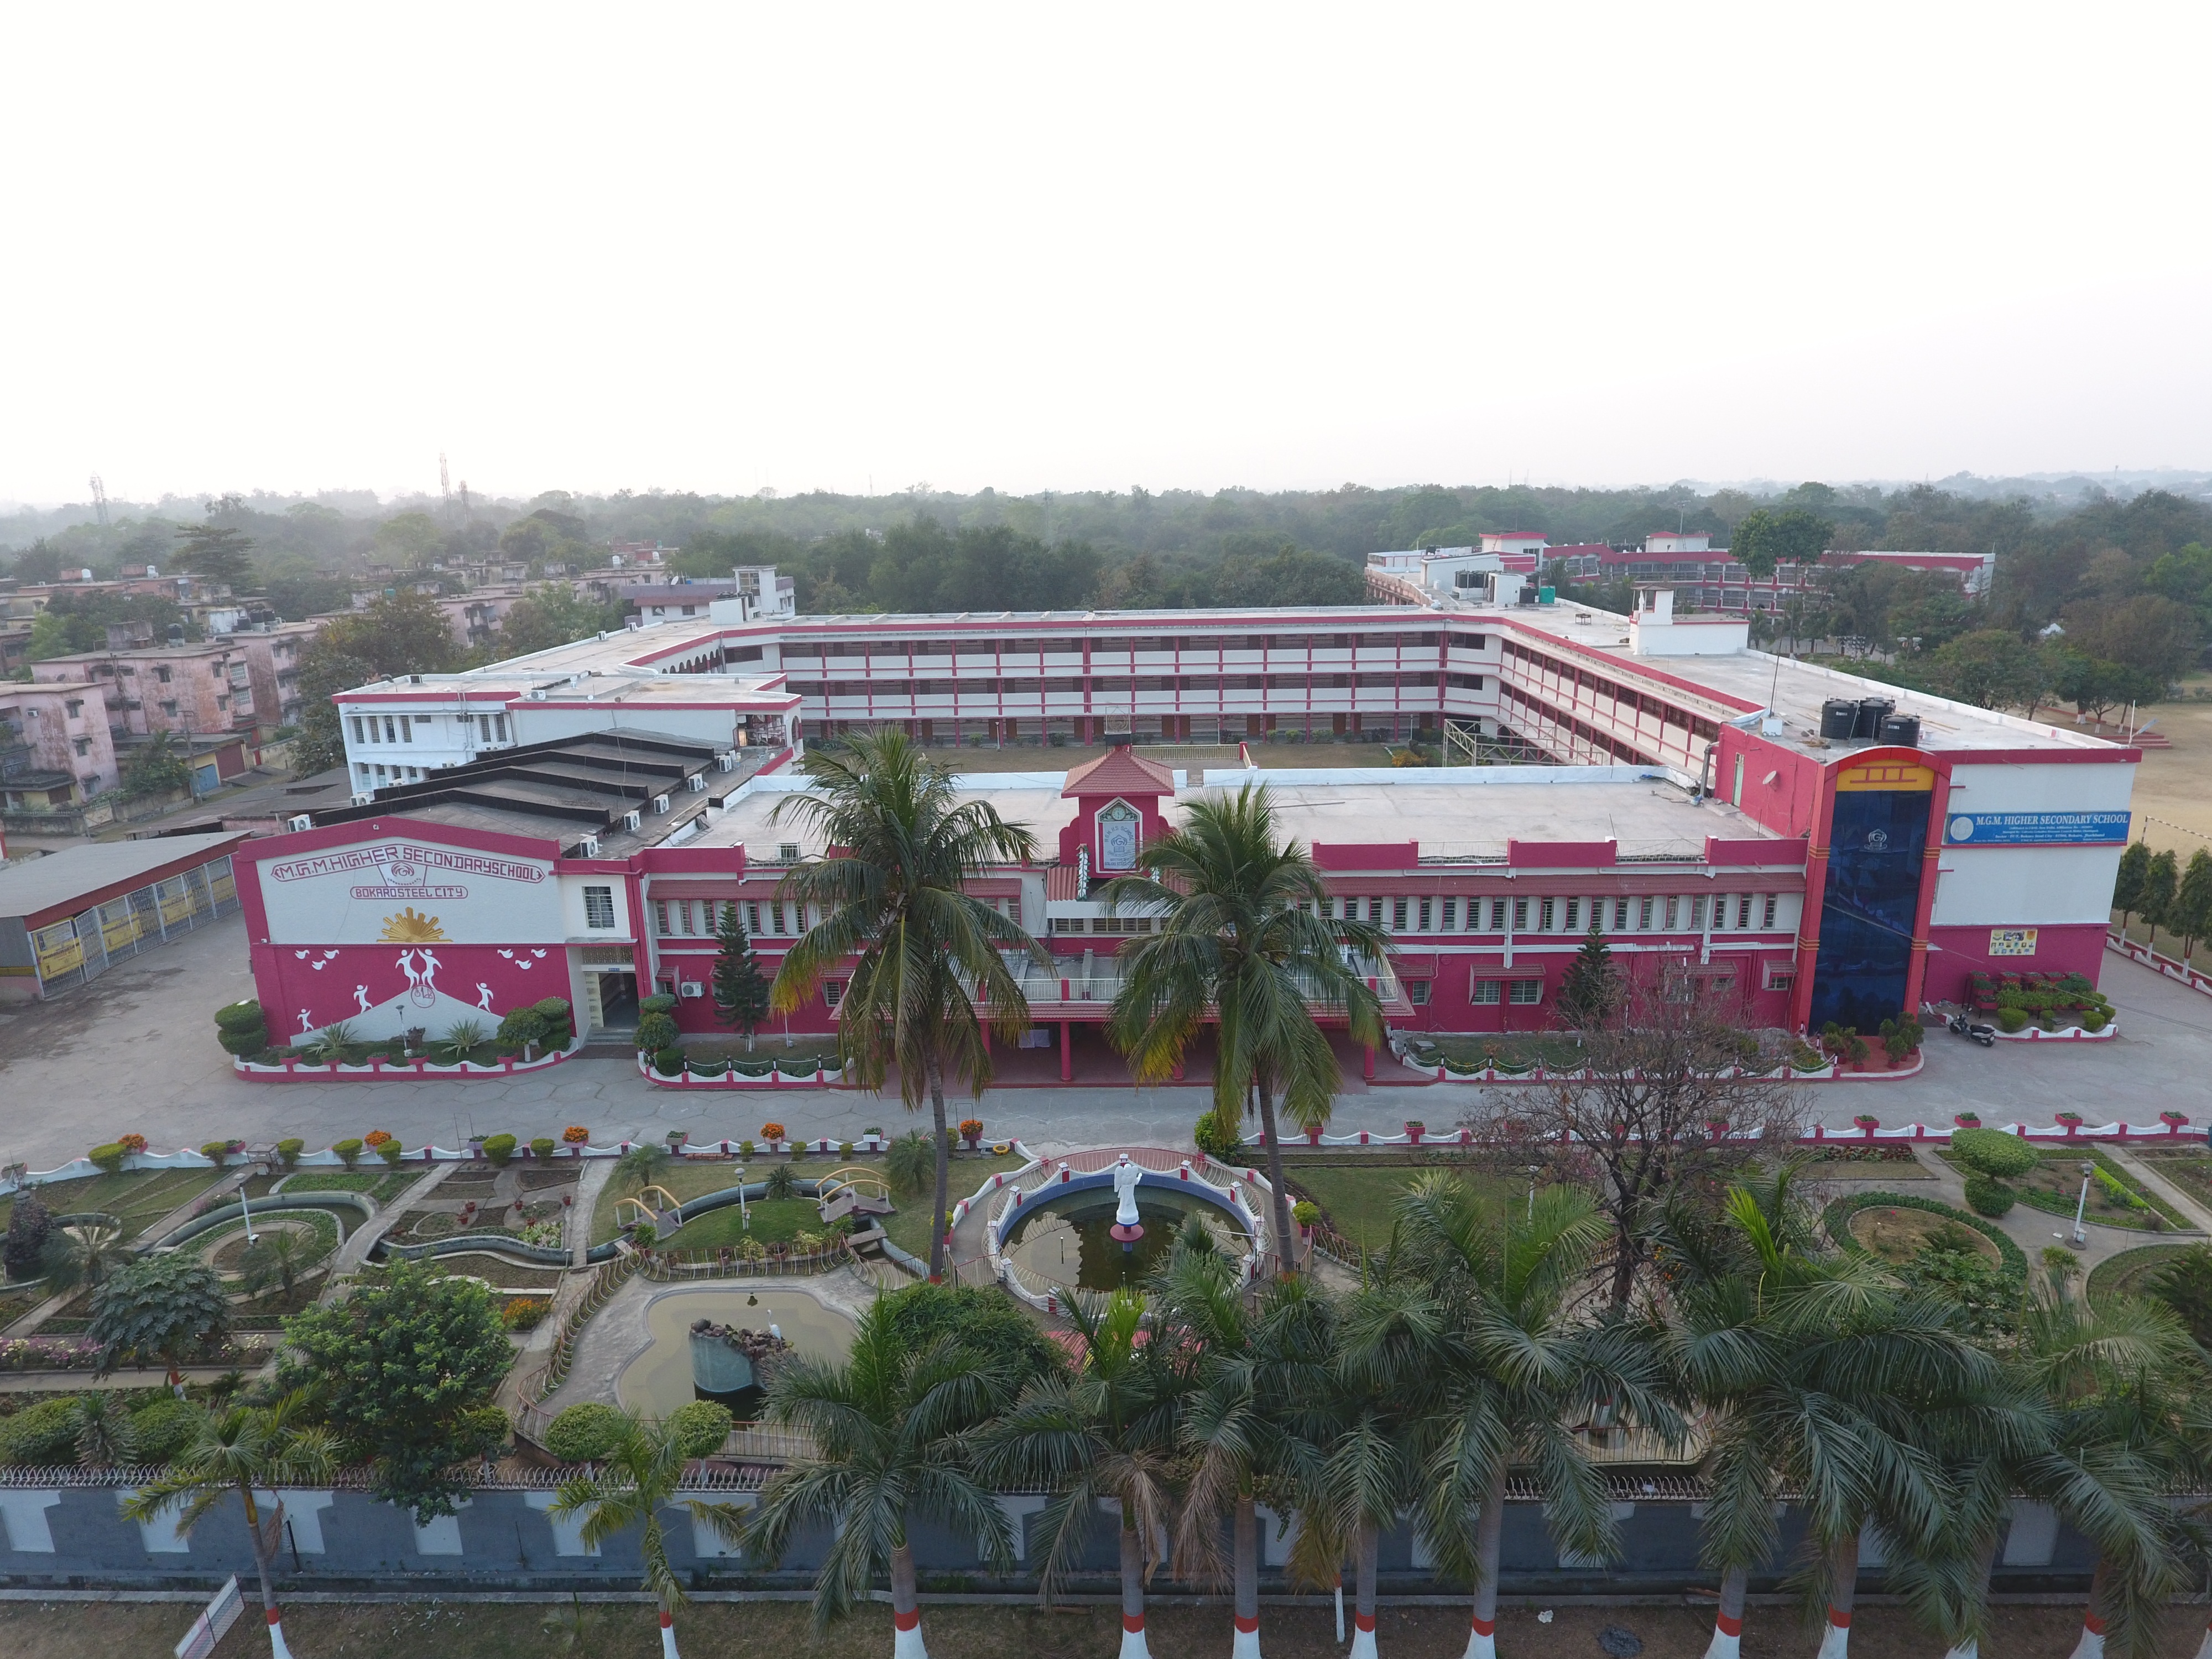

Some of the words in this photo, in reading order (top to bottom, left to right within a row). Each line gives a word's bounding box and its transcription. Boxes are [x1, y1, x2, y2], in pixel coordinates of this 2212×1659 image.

[1976, 816, 2002, 825] M.G.M.
[2004, 815, 2038, 825] HIGHER
[2040, 815, 2092, 825] SECONDARY
[2093, 814, 2128, 823] SCHOOL
[435, 888, 463, 897] CITY
